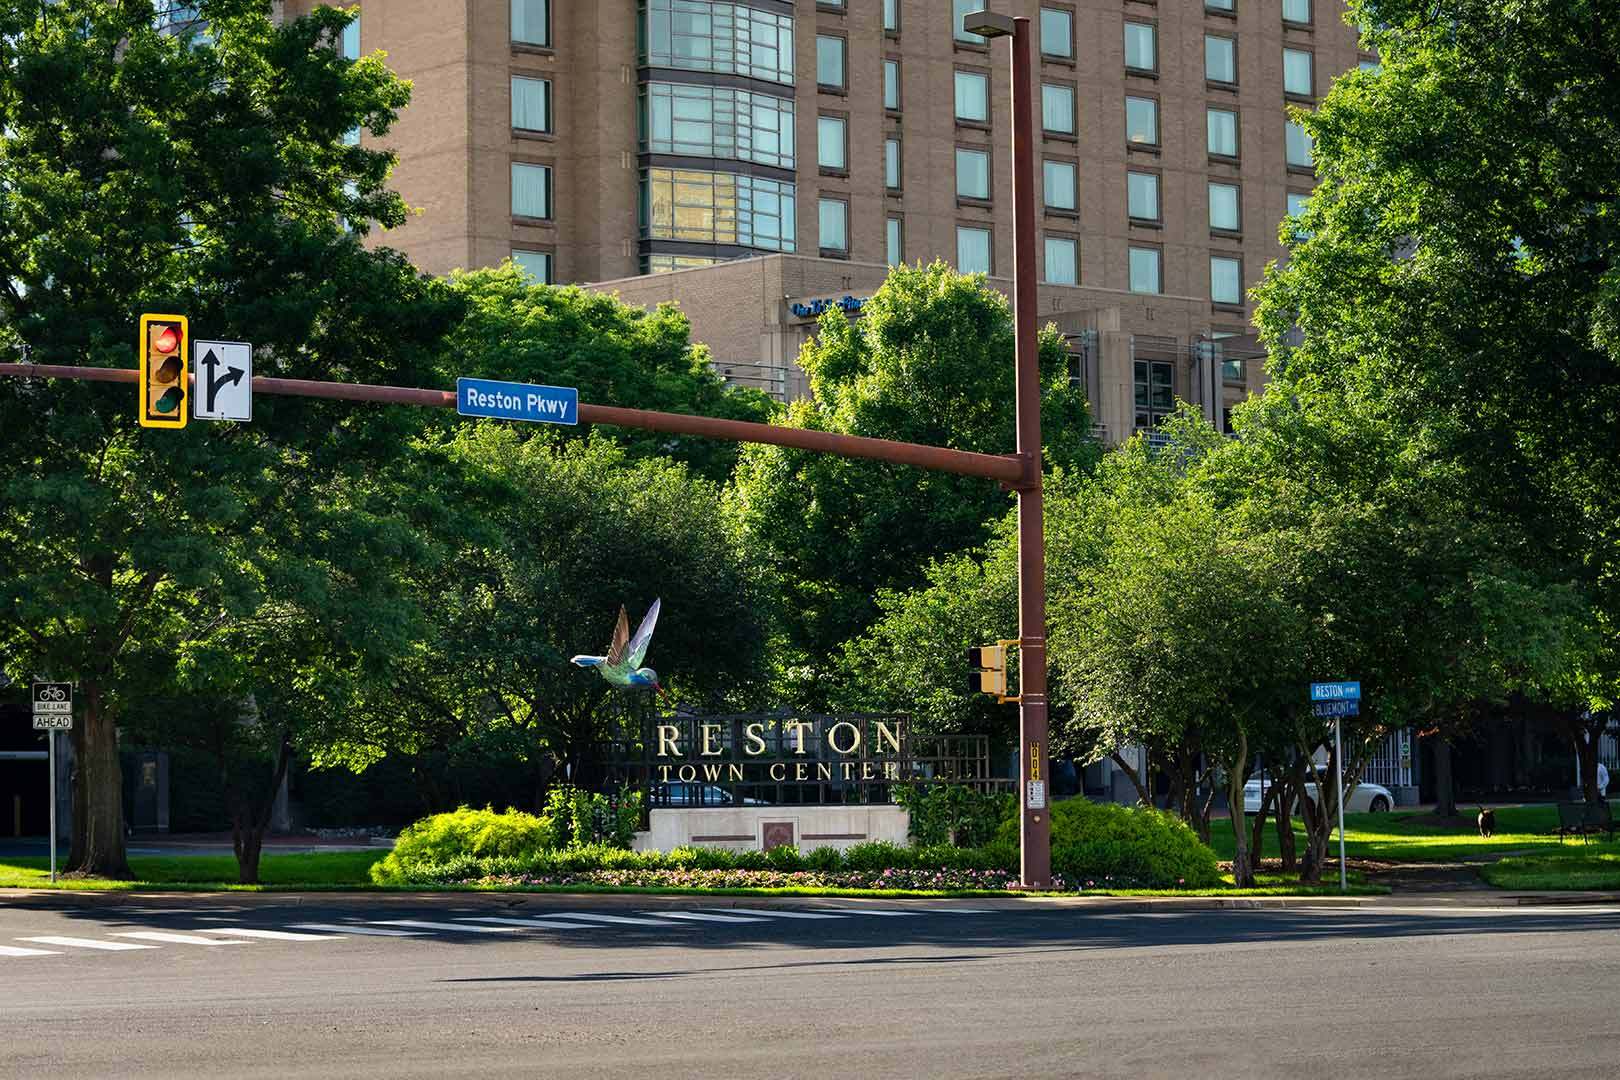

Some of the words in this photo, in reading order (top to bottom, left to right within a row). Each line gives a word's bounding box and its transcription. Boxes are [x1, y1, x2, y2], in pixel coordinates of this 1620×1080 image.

[467, 388, 521, 410] Reston
[527, 393, 568, 419] Pkwy
[1315, 684, 1344, 698] RESTON
[1315, 701, 1350, 717] BLUEMONT
[36, 718, 70, 727] AHEAD
[656, 721, 901, 757] RESTON
[658, 763, 744, 783] TOWN
[769, 762, 900, 781] CENTER
